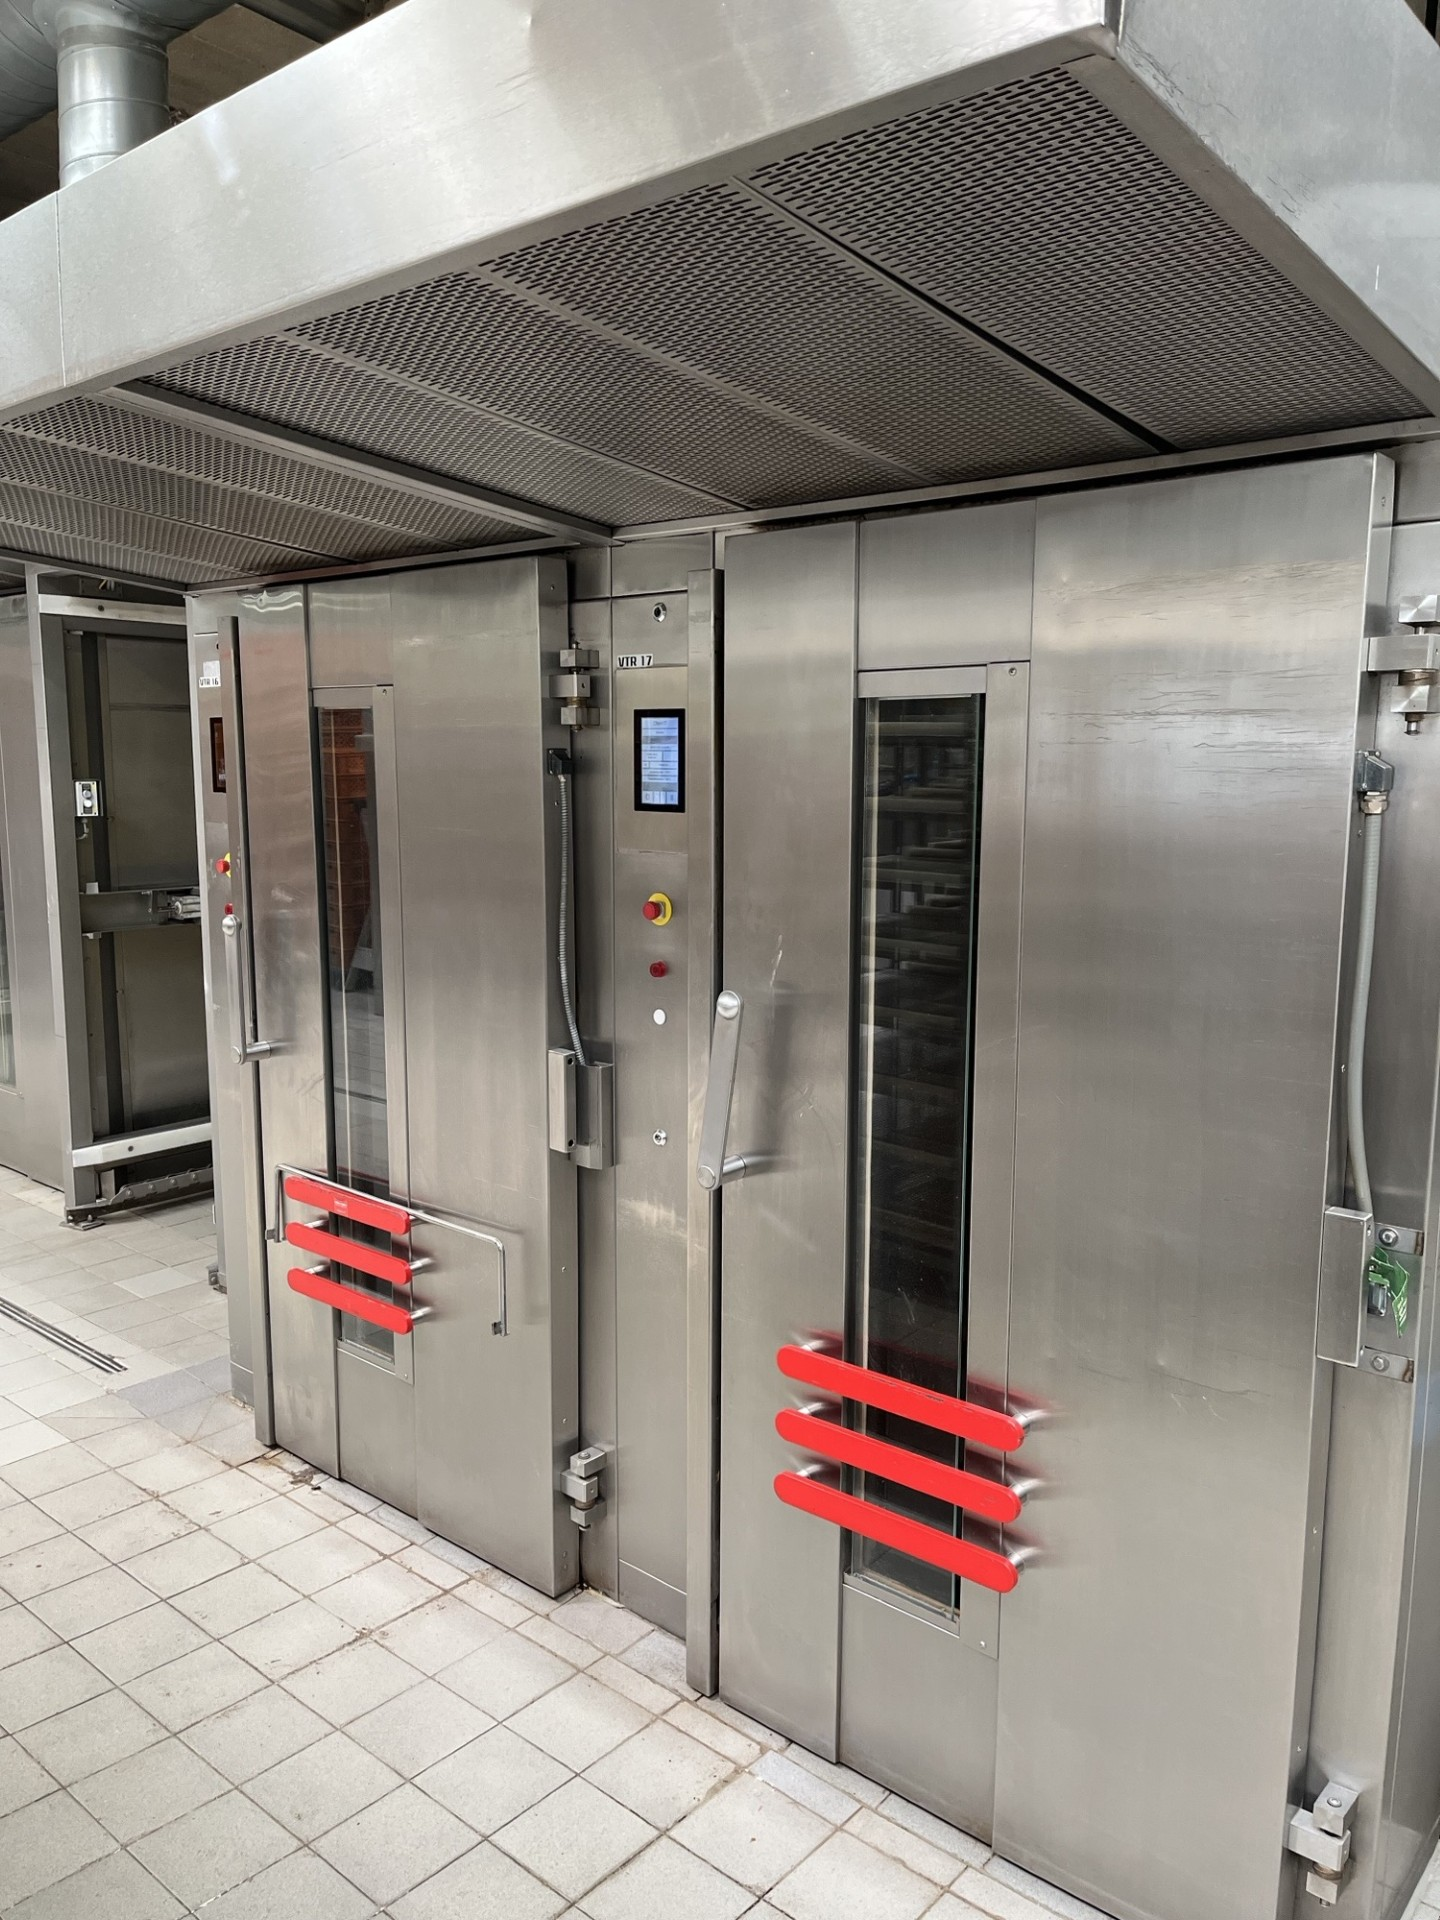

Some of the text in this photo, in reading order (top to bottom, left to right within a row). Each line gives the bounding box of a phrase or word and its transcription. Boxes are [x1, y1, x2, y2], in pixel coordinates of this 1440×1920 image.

[618, 655, 652, 667] VTR 17
[199, 677, 219, 686] VTR 16
